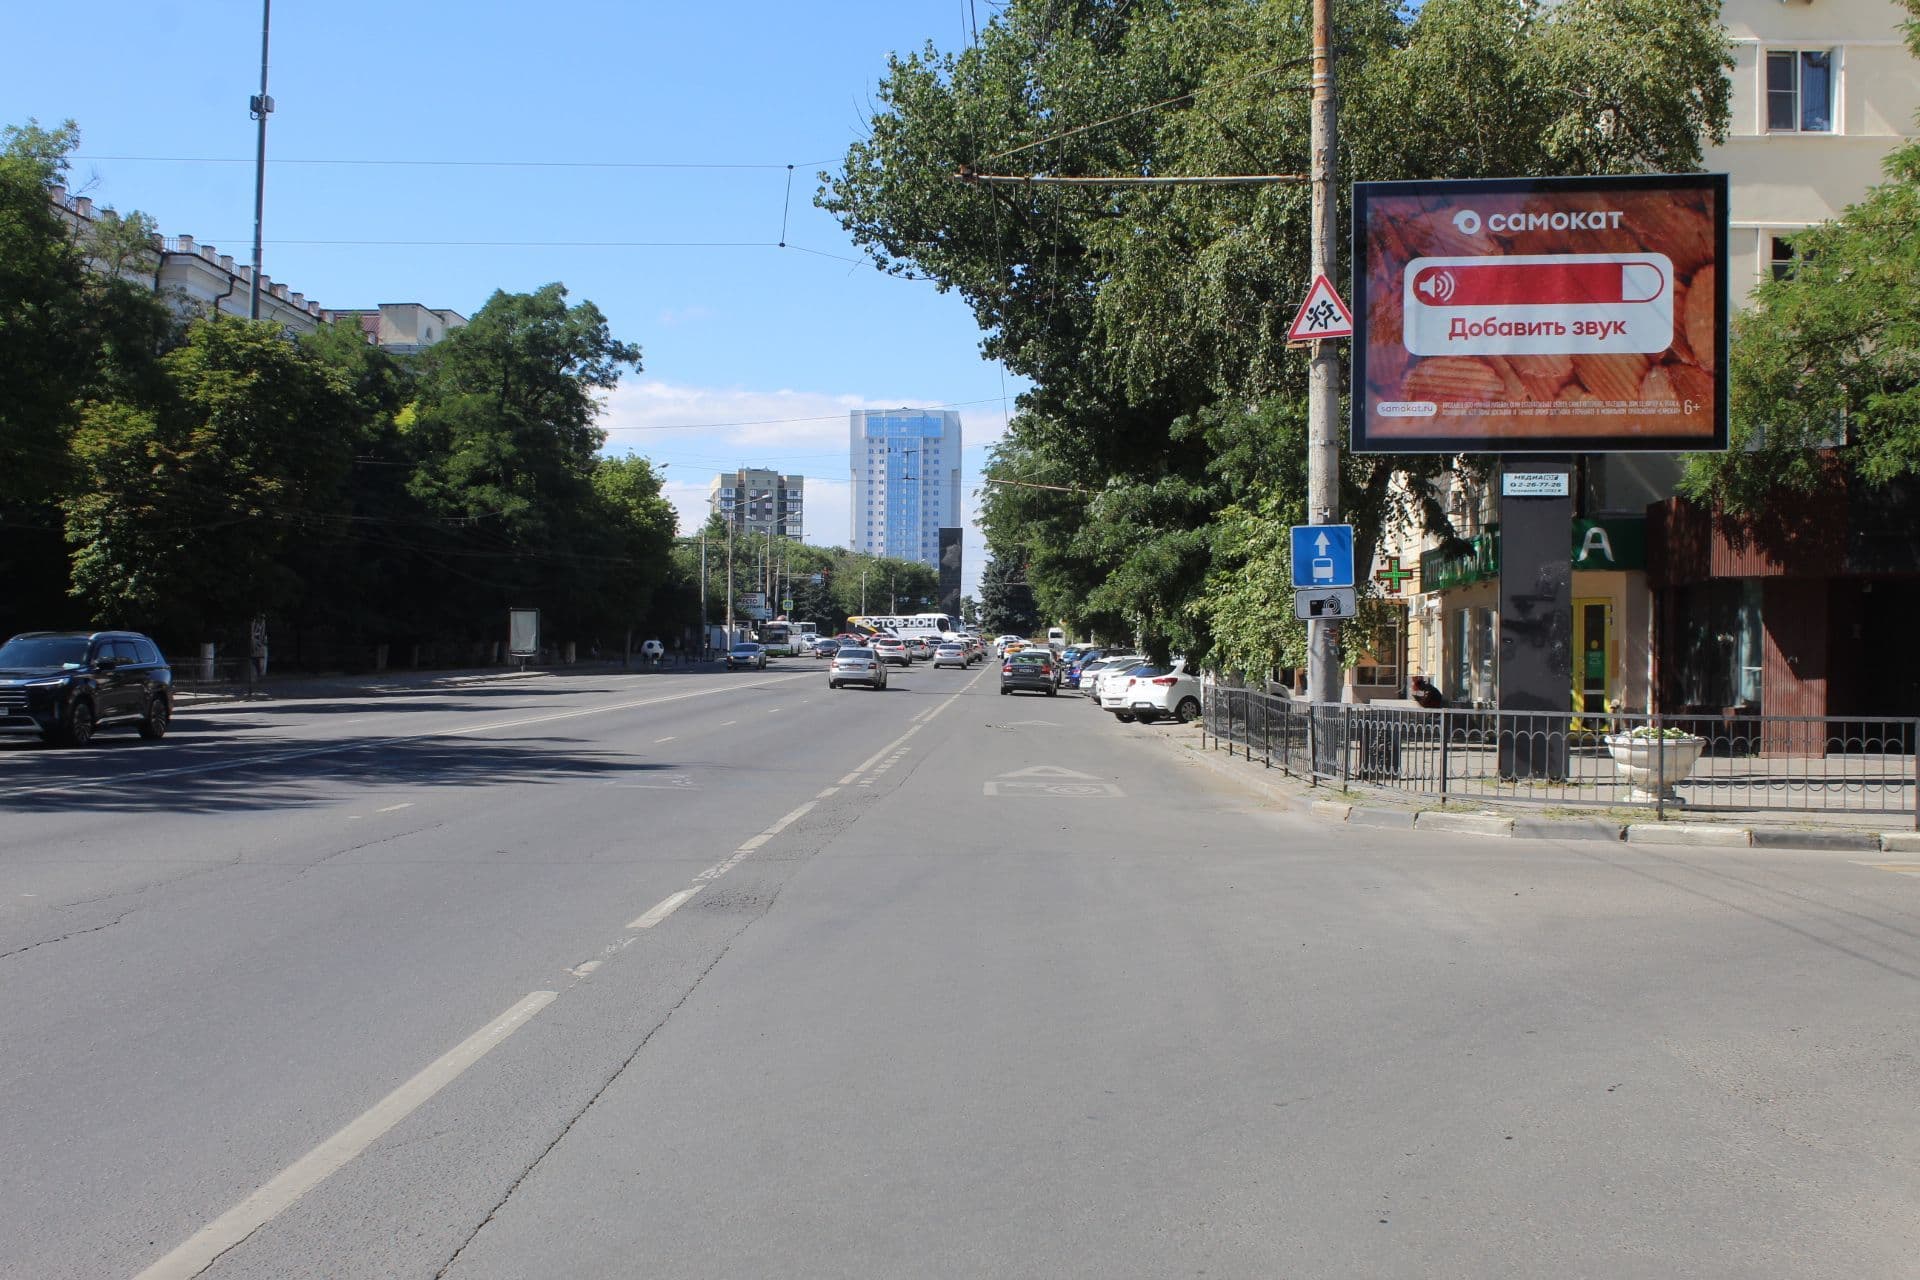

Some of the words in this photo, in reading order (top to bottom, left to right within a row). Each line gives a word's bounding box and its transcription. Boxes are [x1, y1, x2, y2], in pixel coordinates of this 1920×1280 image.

[1488, 210, 1624, 232] самокат
[1448, 316, 1566, 341] Добавить
[1572, 320, 1627, 341] звук
[1380, 403, 1434, 414] samokat.ru
[1683, 399, 1701, 415] 6+
